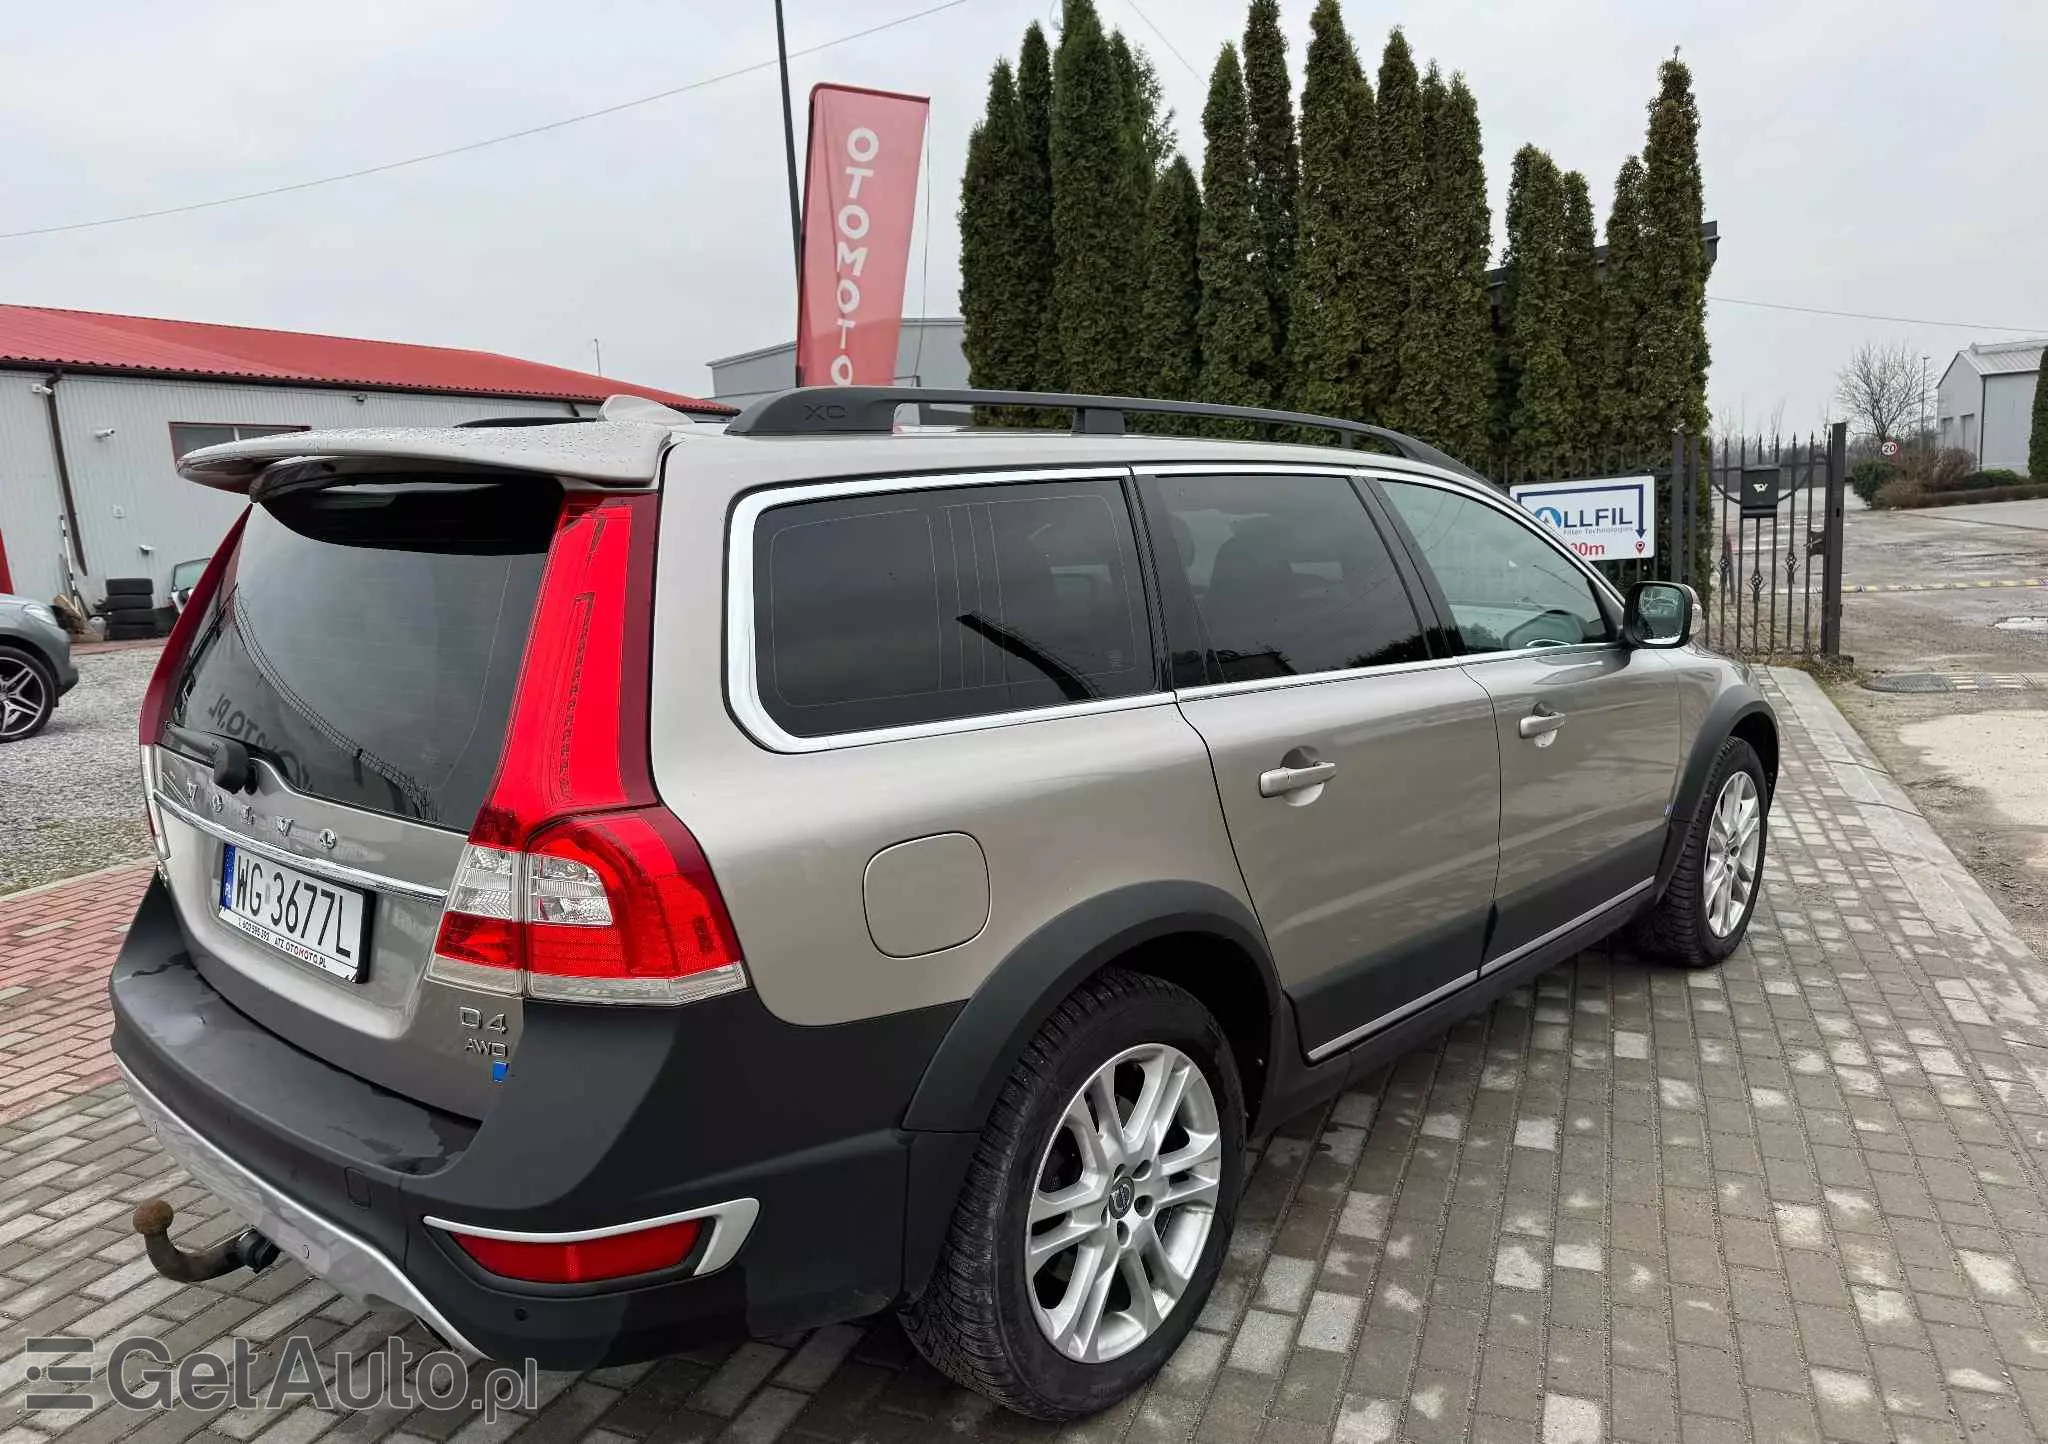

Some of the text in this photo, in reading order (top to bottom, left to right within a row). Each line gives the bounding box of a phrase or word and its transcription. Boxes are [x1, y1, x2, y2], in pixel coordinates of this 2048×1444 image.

[830, 126, 879, 386] OTOMOTO
[804, 405, 847, 421] XC
[1883, 444, 1896, 453] 20
[236, 855, 351, 958] WG 3677L
[465, 1038, 508, 1057] AWD
